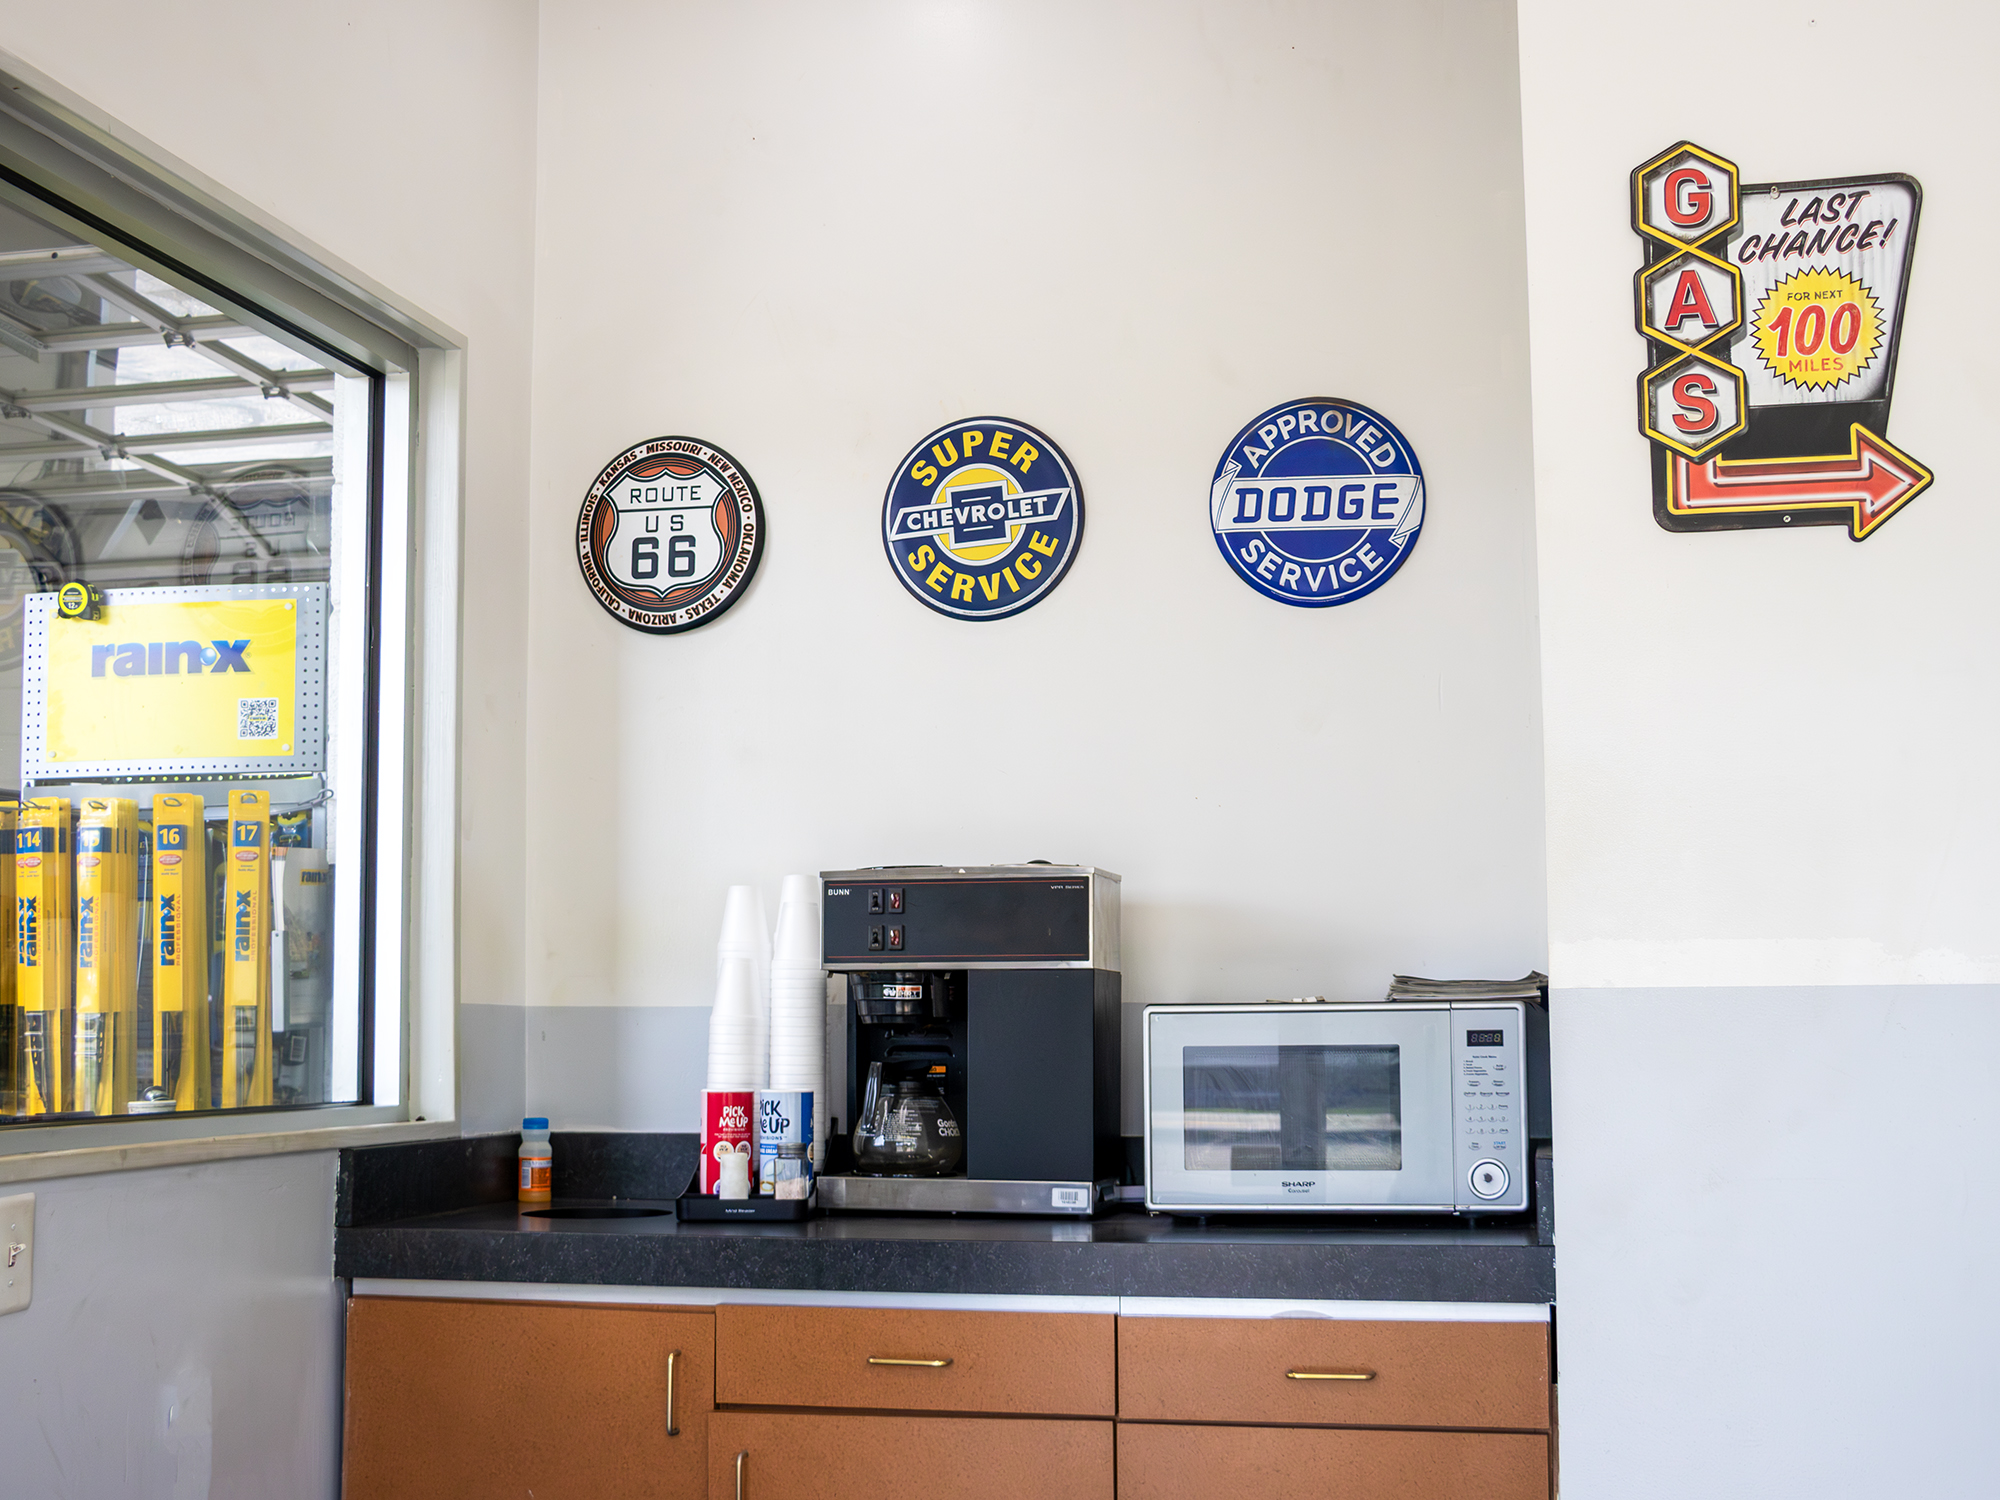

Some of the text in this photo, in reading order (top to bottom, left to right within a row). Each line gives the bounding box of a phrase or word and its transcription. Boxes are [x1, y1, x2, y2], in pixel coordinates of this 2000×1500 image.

[1780, 189, 1871, 229] LAST
[1737, 218, 1898, 265] CHANCE!
[1663, 167, 1719, 435] GAS
[1786, 289, 1844, 302] FOR NEXT
[1767, 302, 1863, 359] 100
[1788, 357, 1845, 374] MILES
[645, 441, 703, 456] MISSOURI
[1242, 409, 1397, 469] APPROVED
[598, 451, 638, 488] KANSAS
[910, 430, 1040, 487] SUPER
[630, 485, 702, 504] ROUTE
[706, 452, 753, 513] NEW MEXICO
[580, 493, 599, 543] ILLINOIS
[906, 496, 1048, 531] CHEVROLET
[1232, 482, 1400, 524] DODGE
[631, 535, 697, 580] 66
[721, 522, 755, 590] OKLAHOMA
[908, 530, 1060, 603] SERVICE
[1240, 538, 1385, 592] SERVICE
[581, 551, 621, 611] CALIFORNIA
[628, 608, 677, 626] ARIZONA
[685, 594, 722, 620] TEXAS
[24, 831, 41, 847] 14
[80, 830, 100, 847] 15
[159, 828, 180, 844] 16
[237, 825, 258, 841] 17
[827, 888, 850, 896] BUNN
[736, 1116, 749, 1127] UP
[769, 1116, 790, 1133] UP
